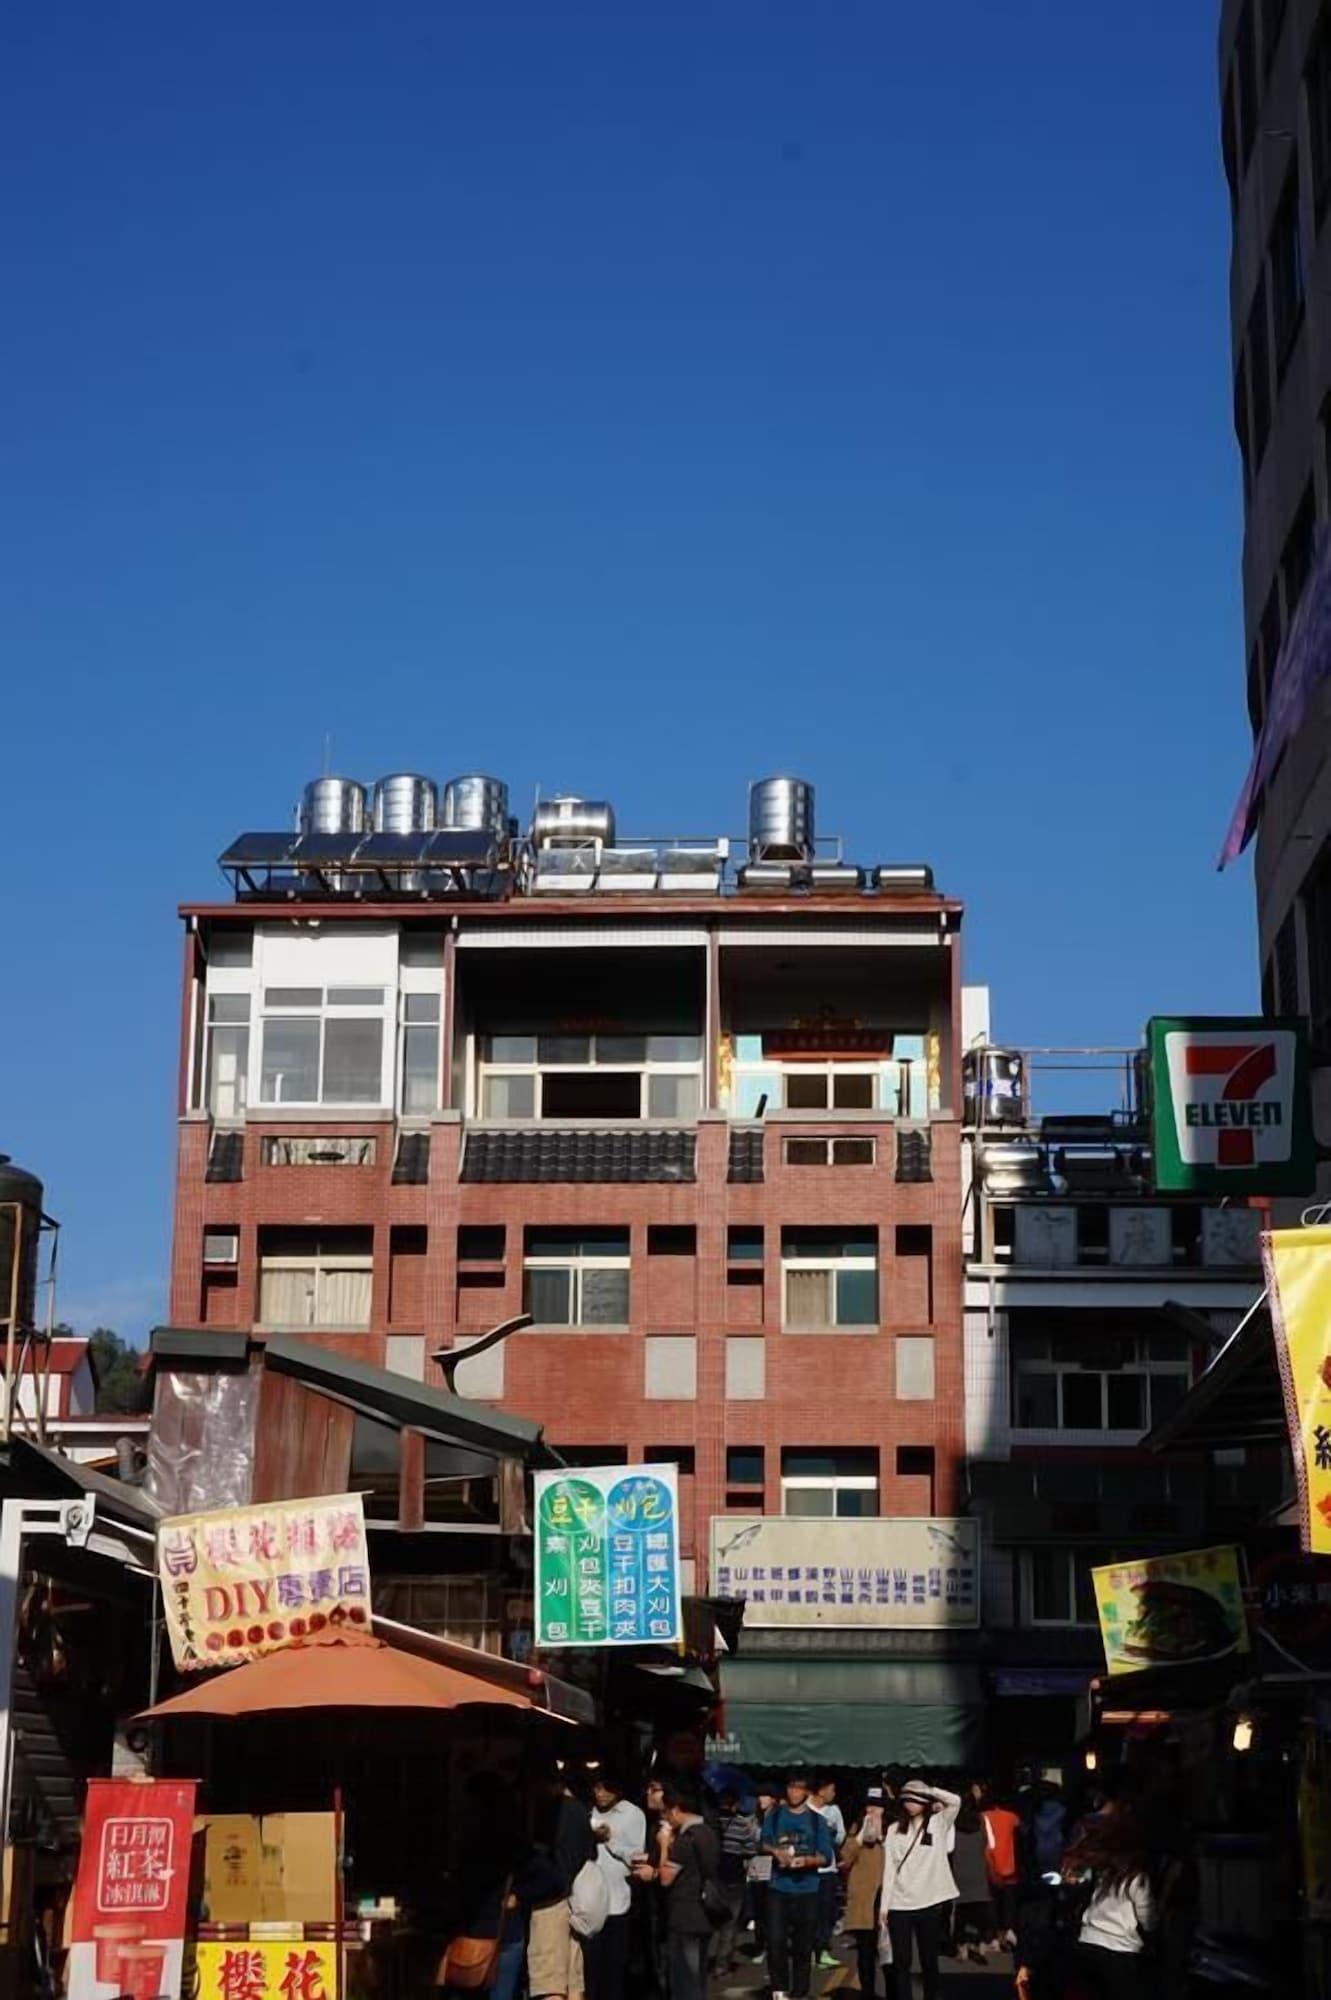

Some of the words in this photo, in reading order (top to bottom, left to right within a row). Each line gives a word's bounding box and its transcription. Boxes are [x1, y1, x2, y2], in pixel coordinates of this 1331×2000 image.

[1185, 1043, 1277, 1166] 7
[203, 1577, 274, 1623] DIY
[109, 1824, 166, 1846] 日月潭
[106, 1849, 165, 1880] 紅茶
